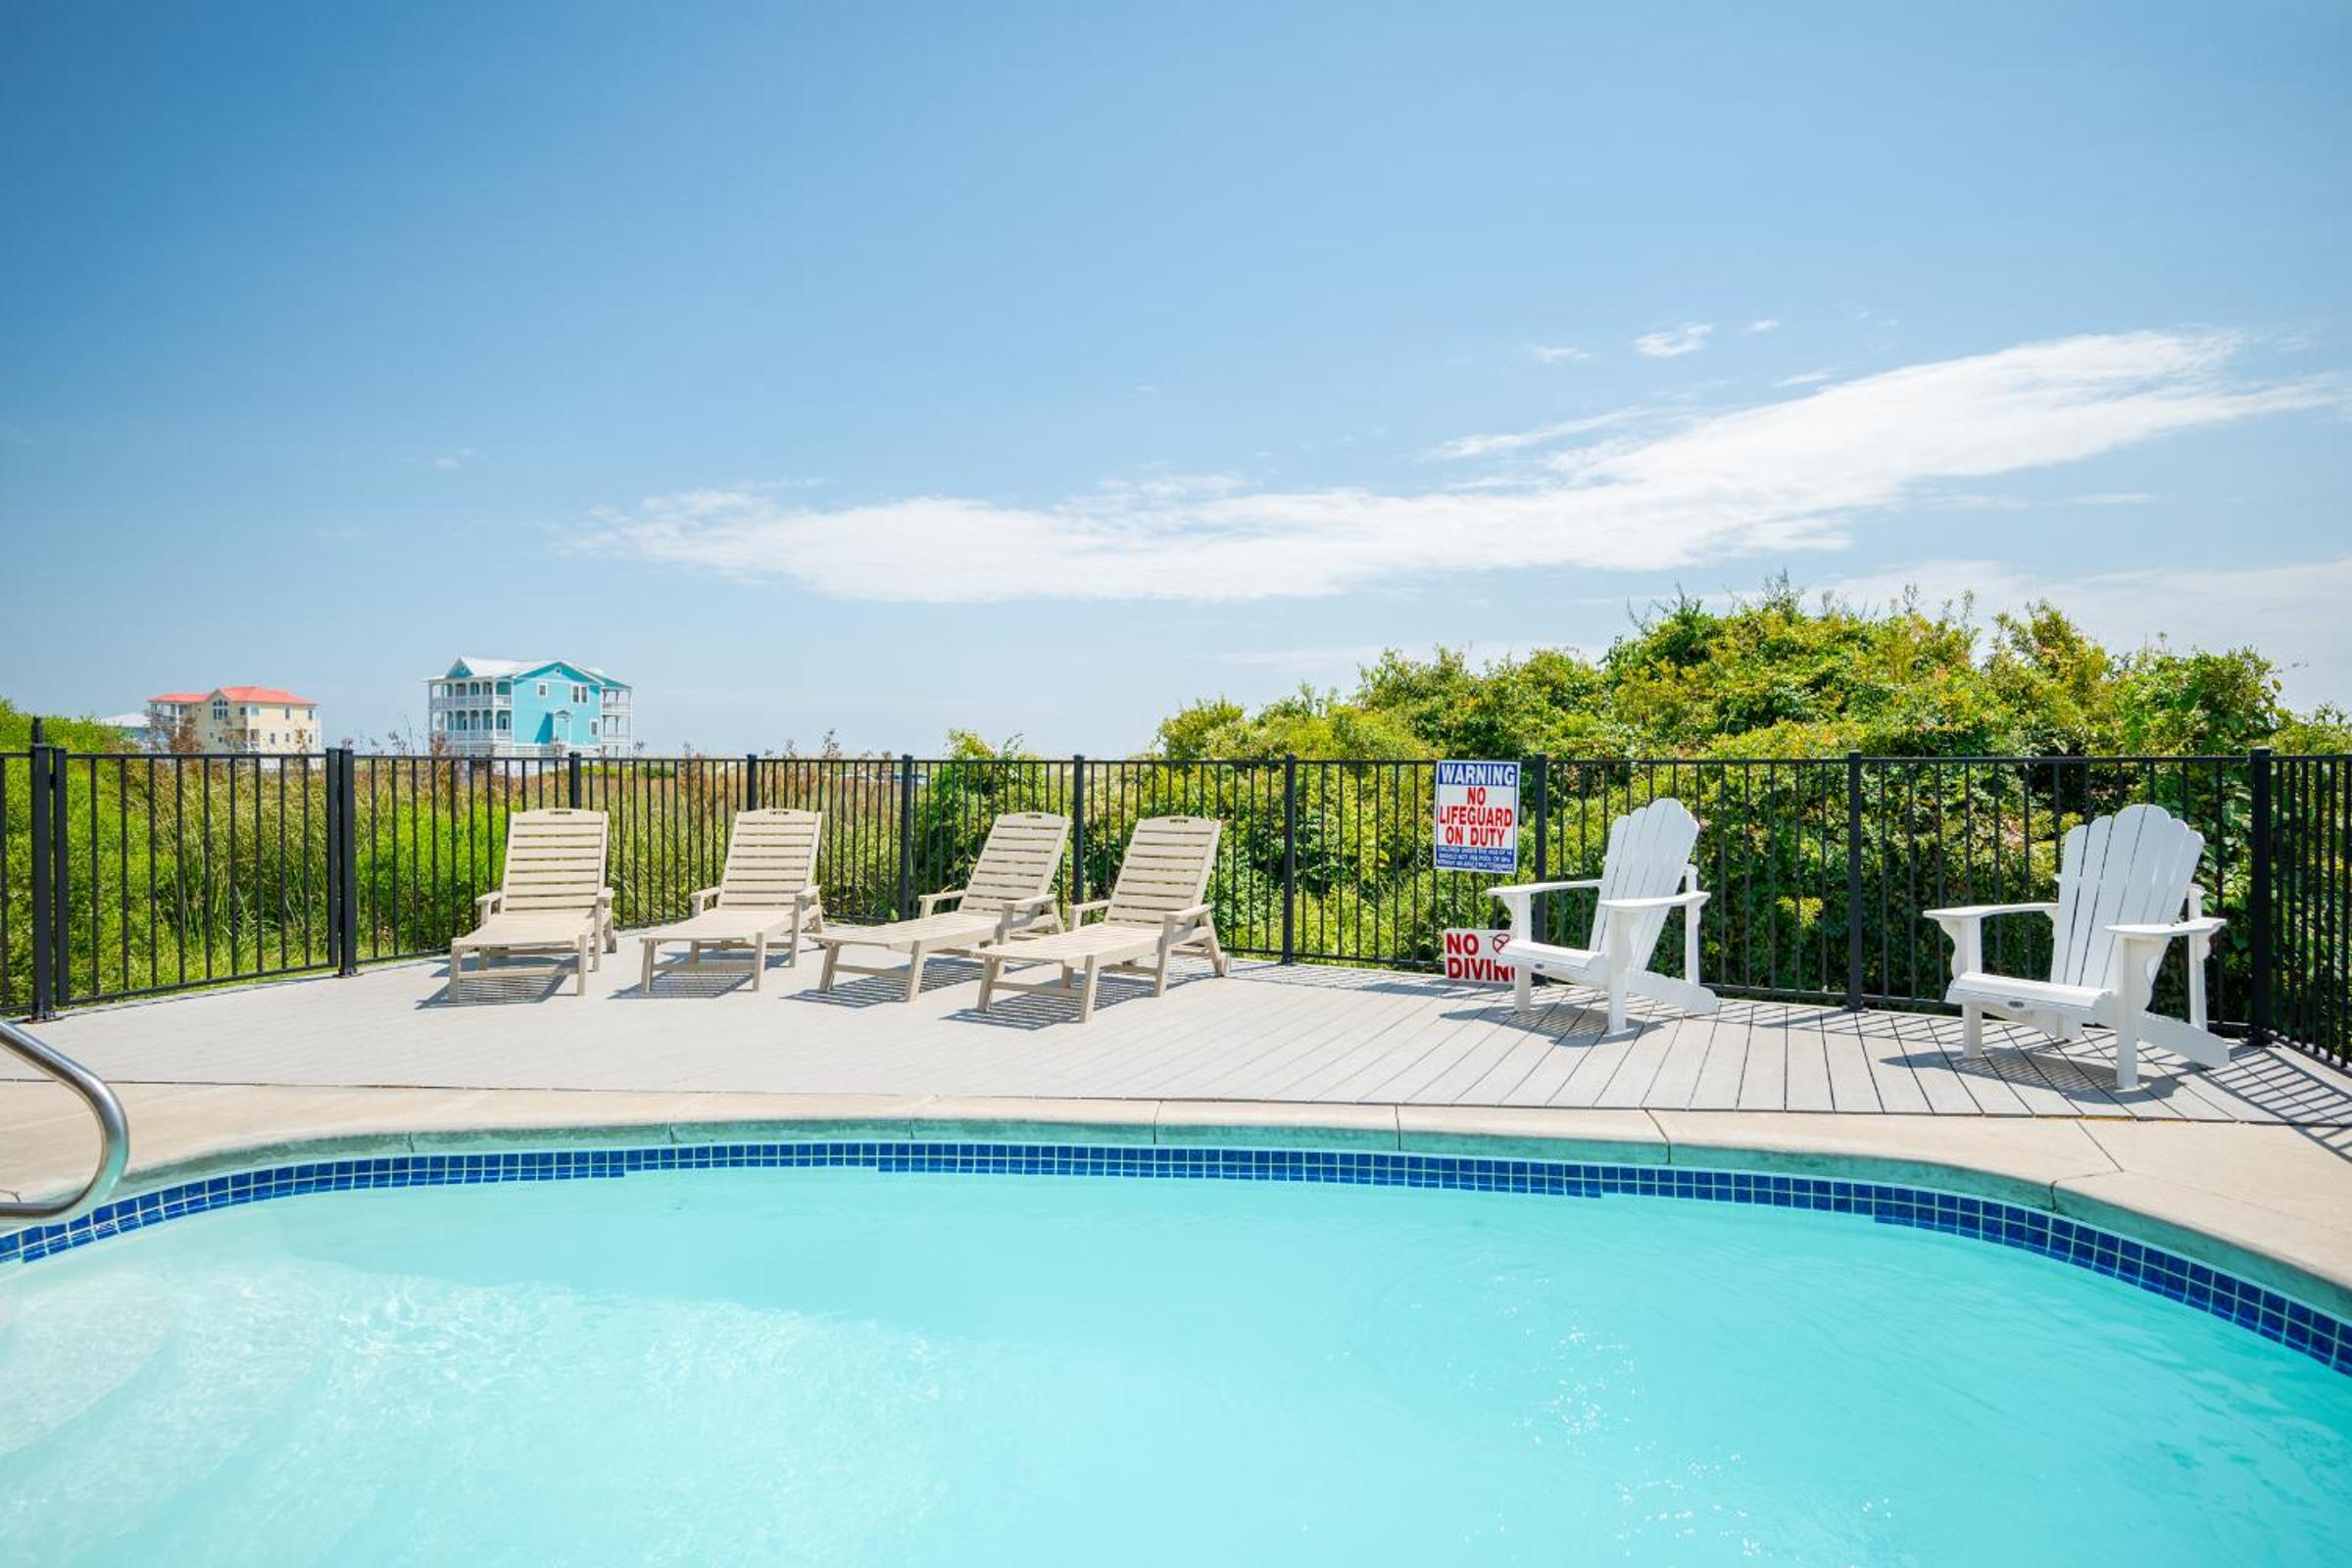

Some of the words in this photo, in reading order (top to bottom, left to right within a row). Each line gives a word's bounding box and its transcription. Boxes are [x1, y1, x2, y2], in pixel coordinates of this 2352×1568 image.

[1441, 764, 1515, 785] WARNING
[1467, 787, 1486, 806] NO
[1439, 806, 1513, 827] LIFEGUARD
[1446, 826, 1463, 845] ON
[1470, 827, 1505, 847] DUTY
[1446, 933, 1479, 956] NO
[1446, 956, 1515, 982] DIVIN
